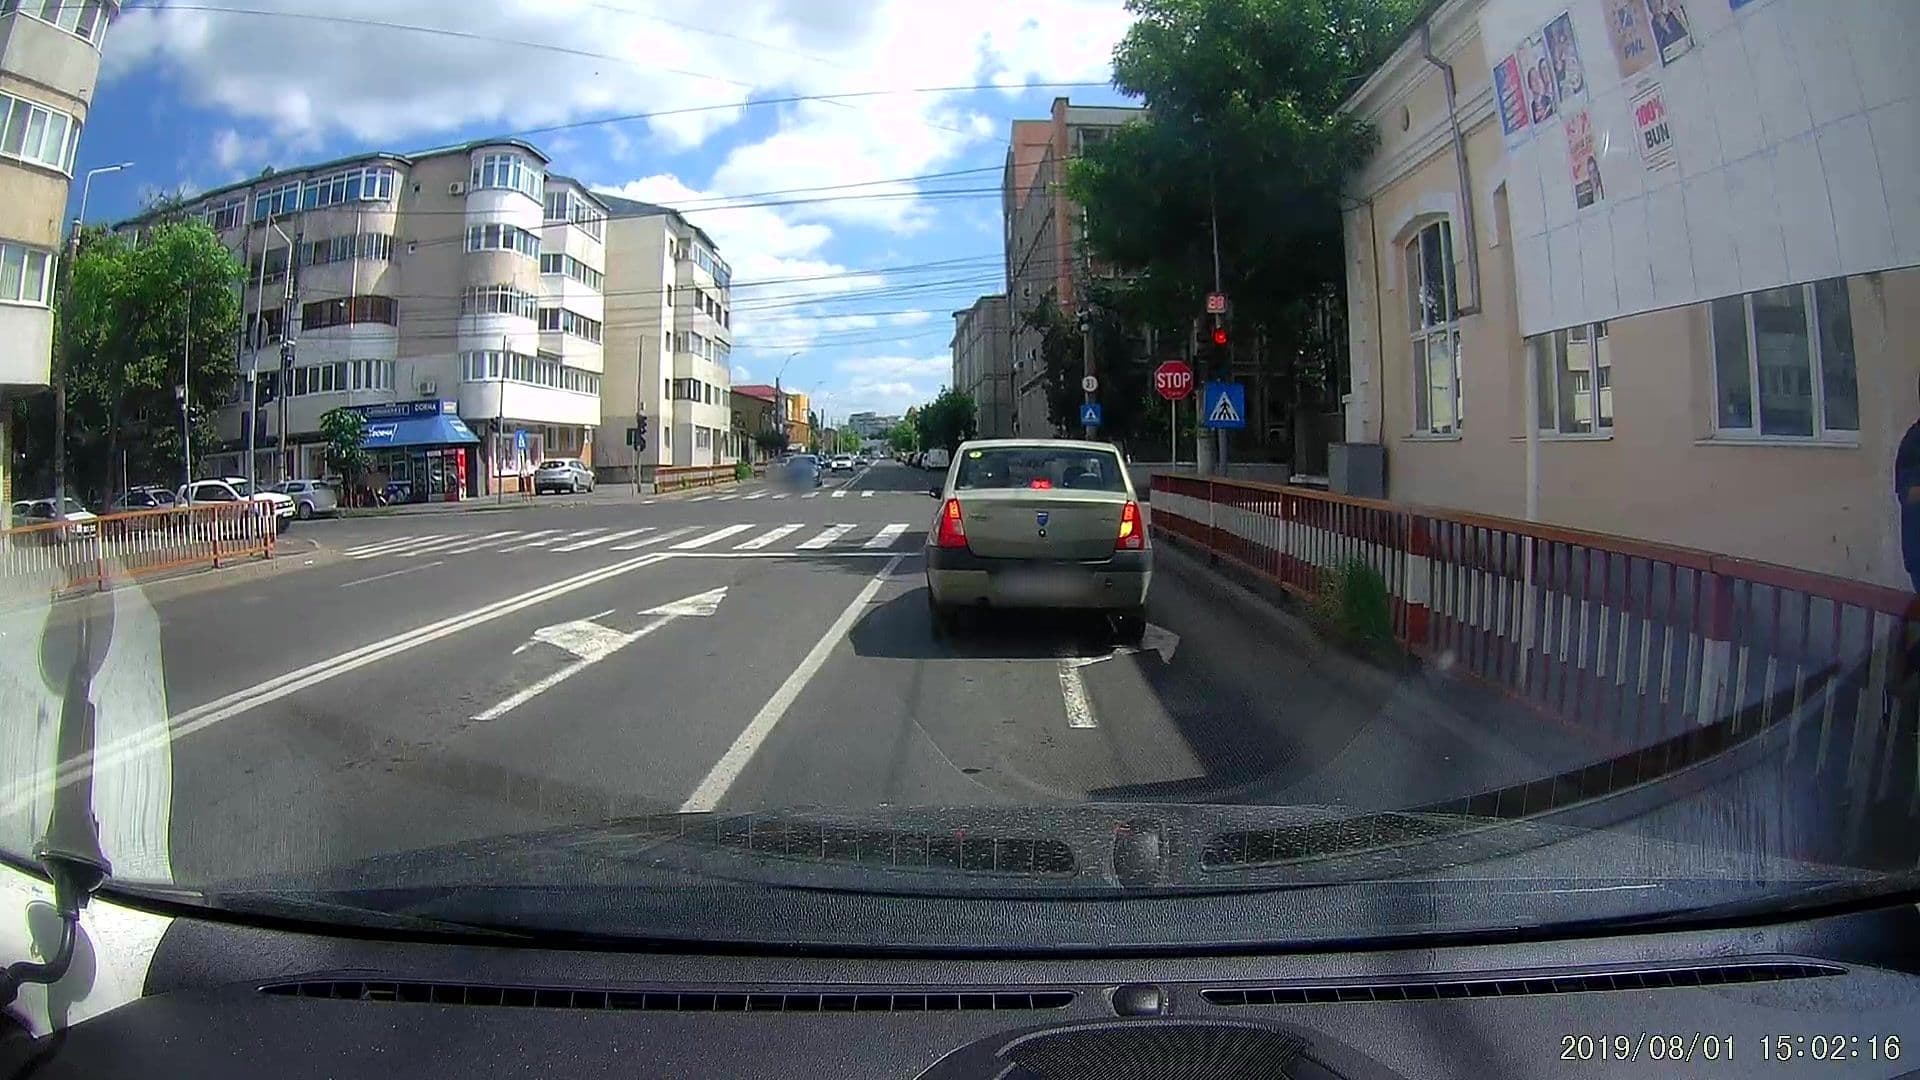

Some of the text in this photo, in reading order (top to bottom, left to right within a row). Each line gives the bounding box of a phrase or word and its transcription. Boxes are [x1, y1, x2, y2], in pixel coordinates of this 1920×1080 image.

[1624, 38, 1645, 58] PNL
[1635, 95, 1665, 128] 100%
[1644, 122, 1670, 149] BUN
[1157, 372, 1190, 389] STOP
